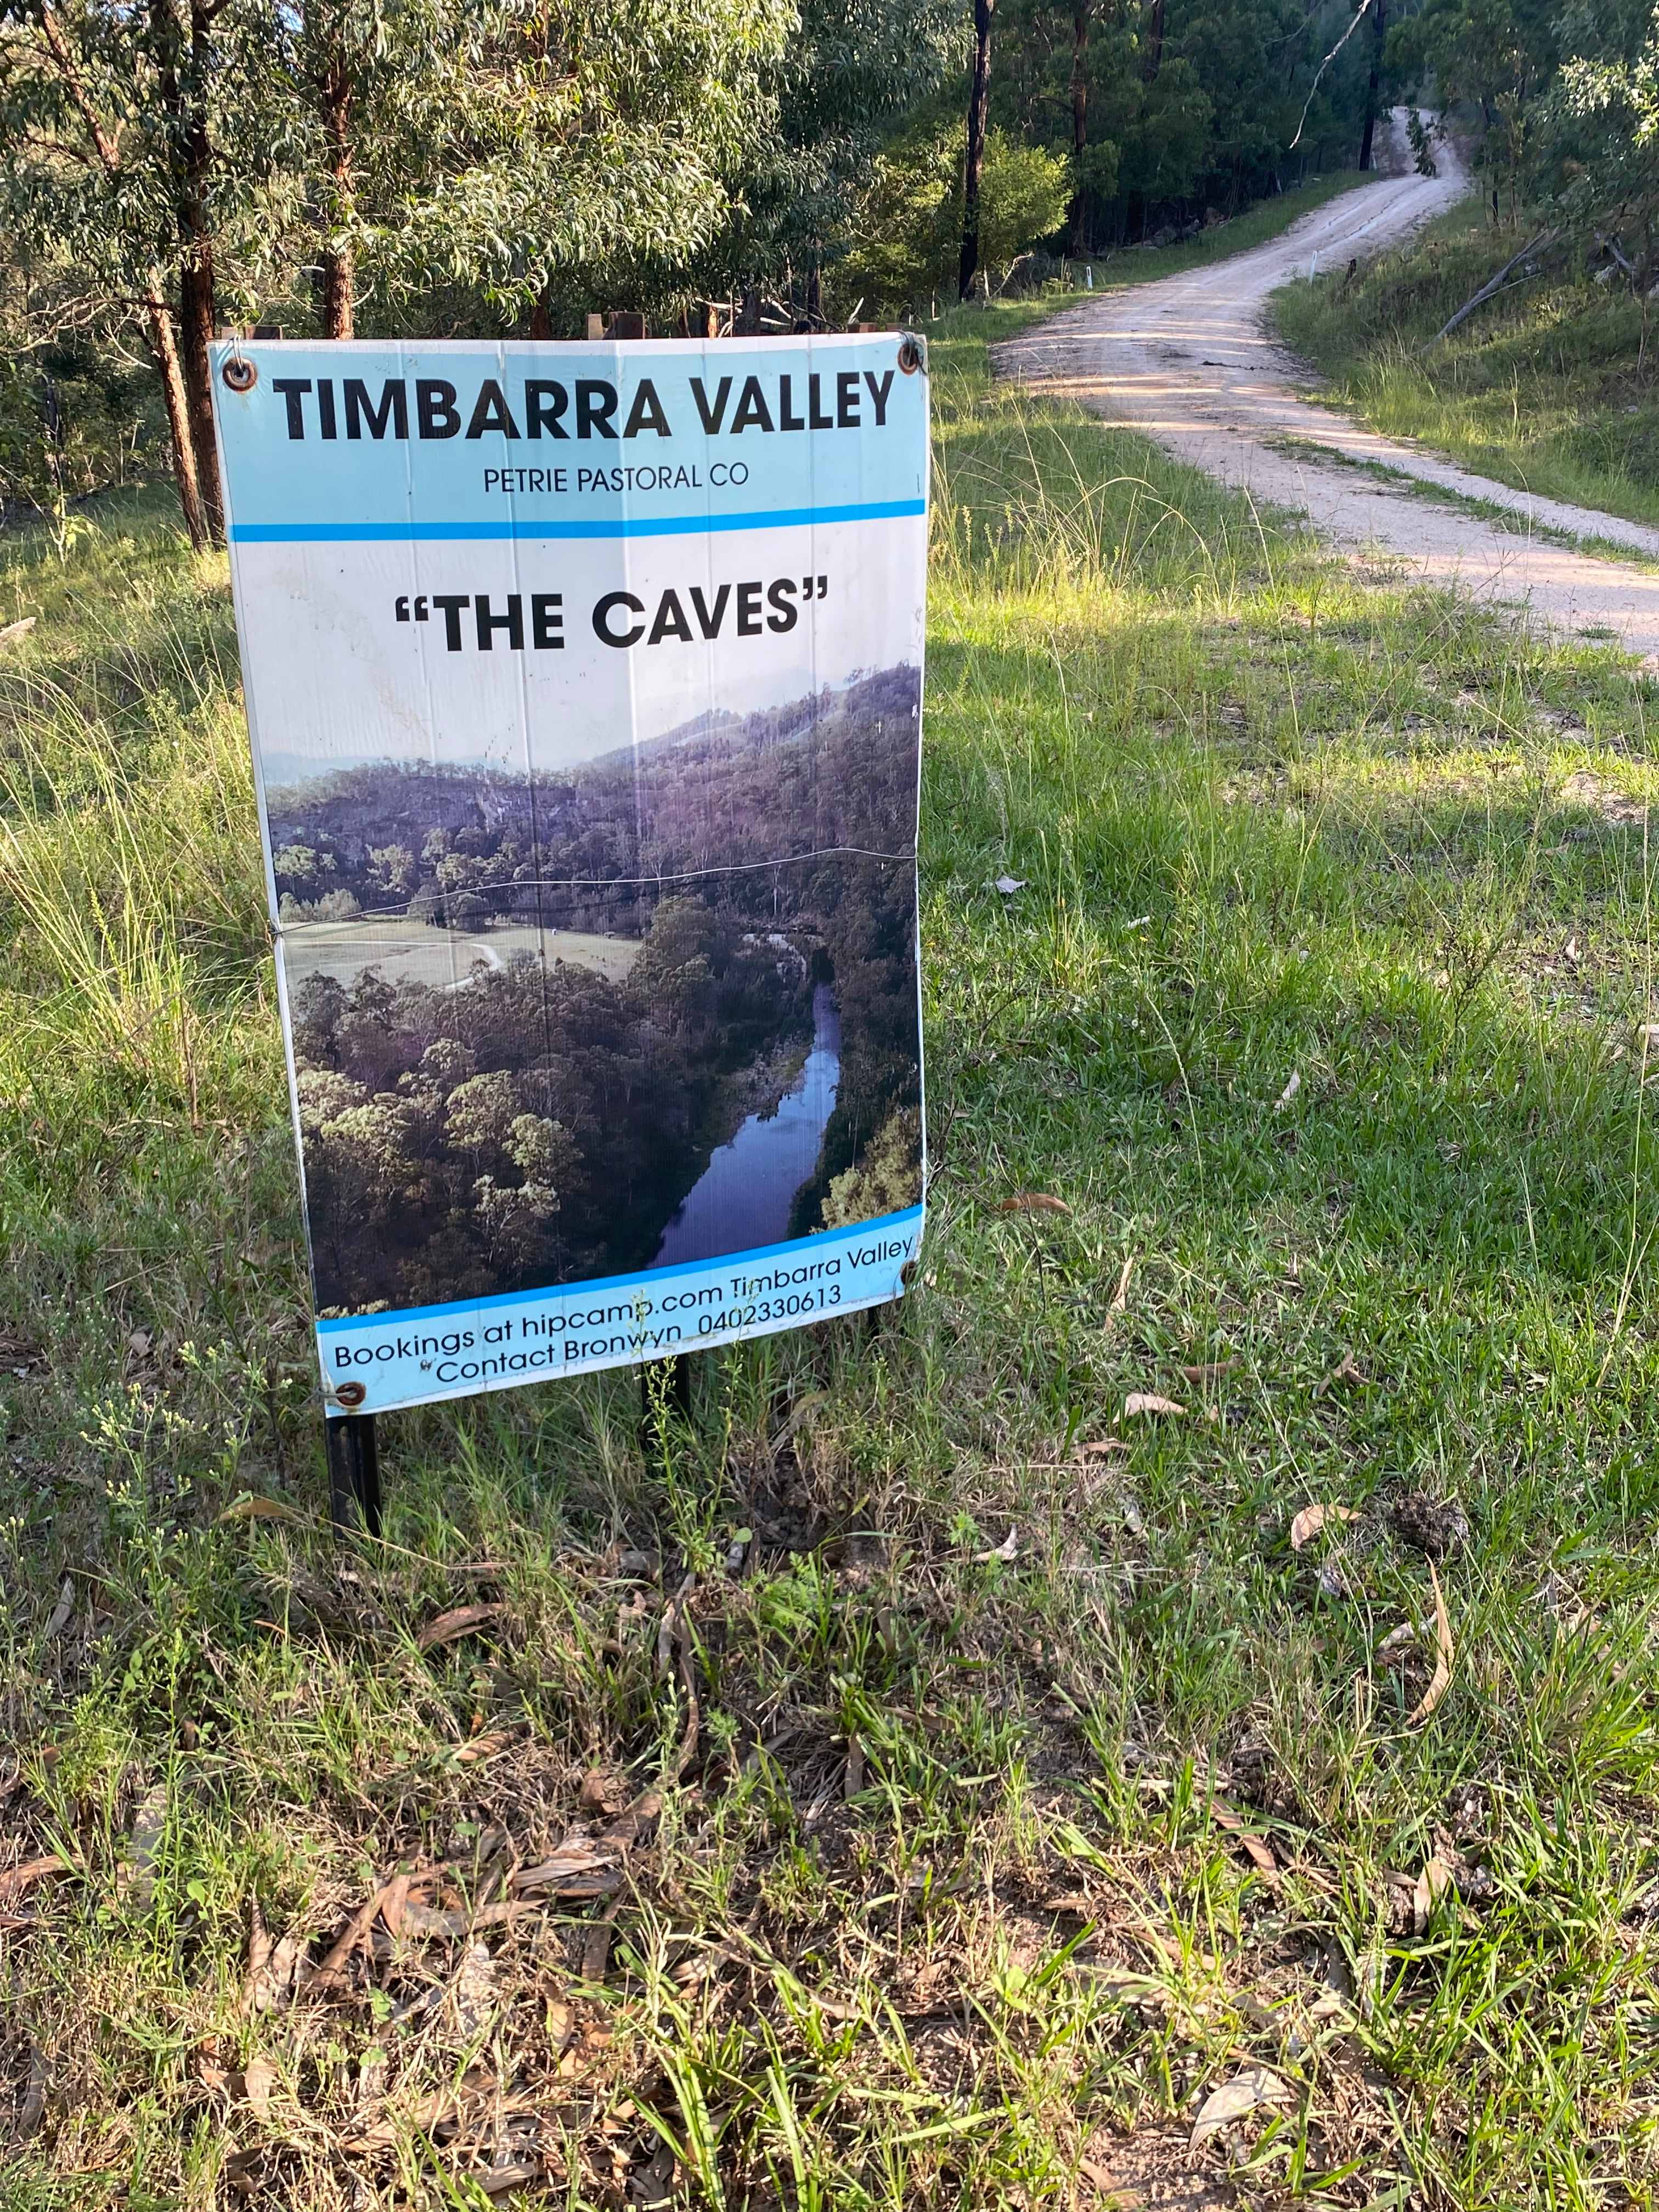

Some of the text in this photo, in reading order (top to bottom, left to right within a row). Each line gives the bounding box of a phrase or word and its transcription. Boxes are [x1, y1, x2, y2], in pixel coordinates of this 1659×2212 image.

[273, 370, 895, 439] TIMBARRA VALLEY
[484, 462, 749, 493] PETRIE PASTORAL CO
[335, 1235, 913, 1368] Bookings at hipcamp.com Timbarra Valley
[436, 1285, 841, 1383] Contact Bronwyn 0402330613
